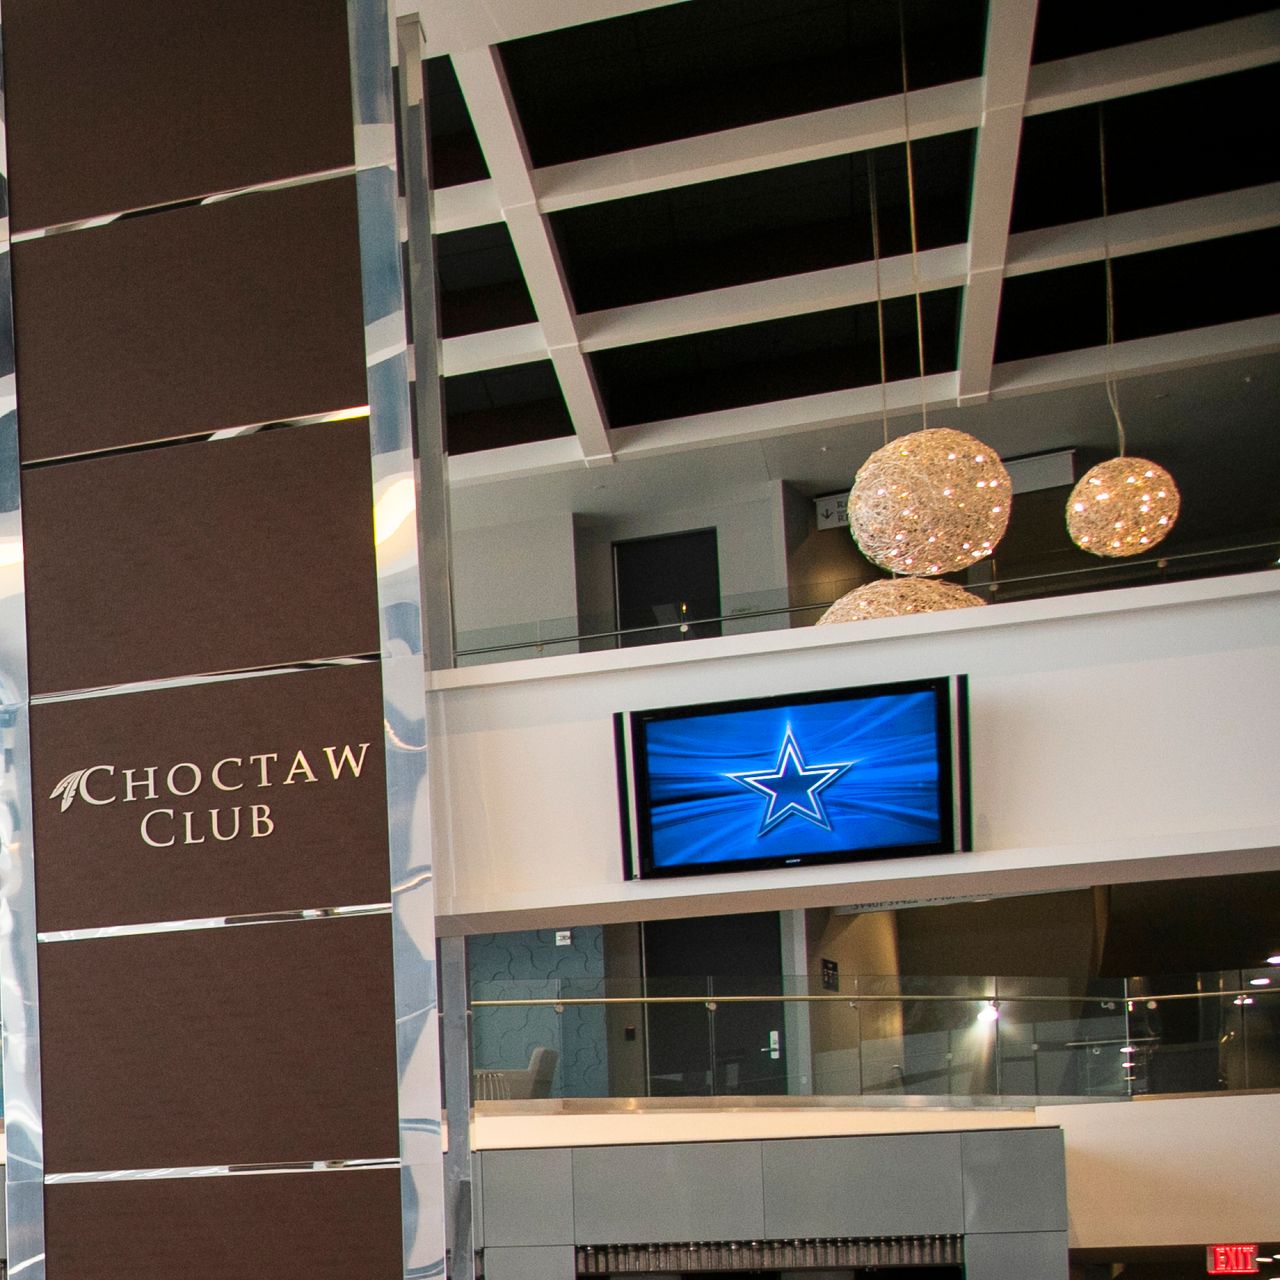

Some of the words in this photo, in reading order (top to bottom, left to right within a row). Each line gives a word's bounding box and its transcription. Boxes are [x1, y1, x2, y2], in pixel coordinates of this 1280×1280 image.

[77, 743, 371, 807] CHOCTAW
[140, 804, 276, 848] CLUB
[1215, 1247, 1255, 1271] EXIT
